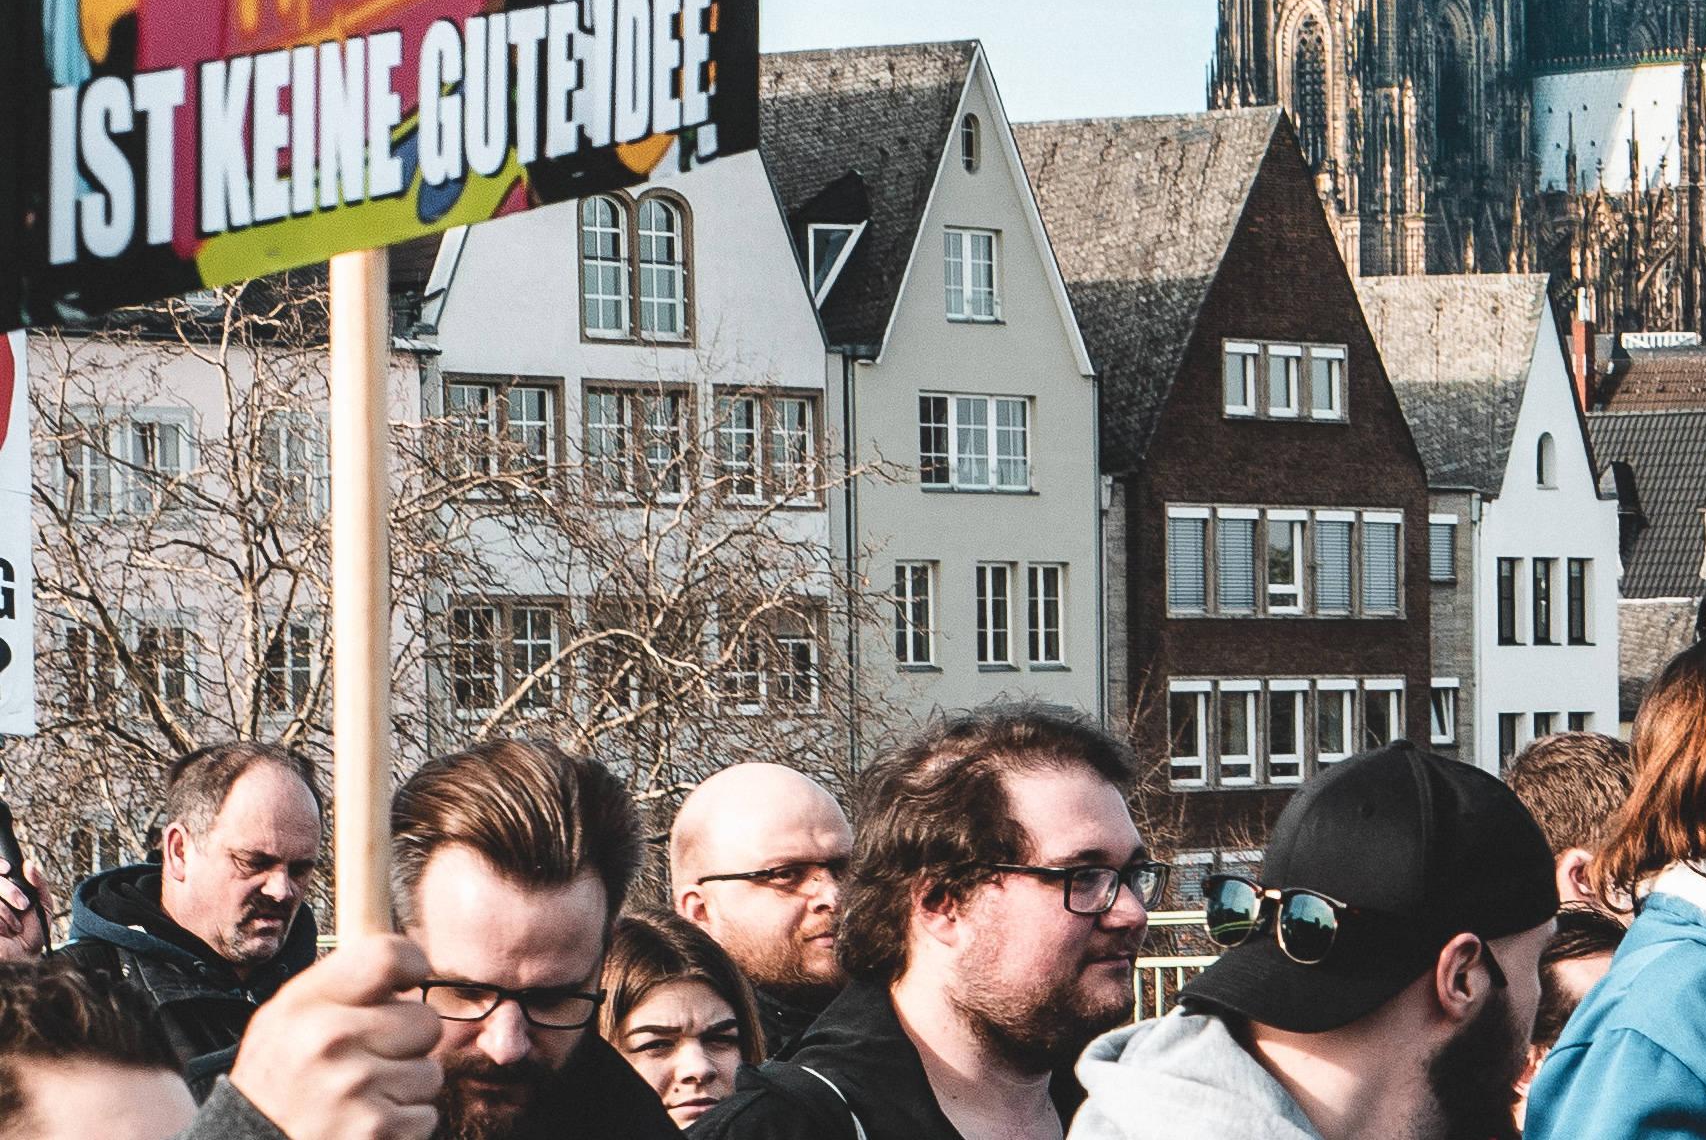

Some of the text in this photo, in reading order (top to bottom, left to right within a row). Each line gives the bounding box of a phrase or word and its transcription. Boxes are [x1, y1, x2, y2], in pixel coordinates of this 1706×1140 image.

[49, 67, 186, 264] IST
[201, 31, 403, 233] KEINE
[417, 1, 584, 186] GUTE
